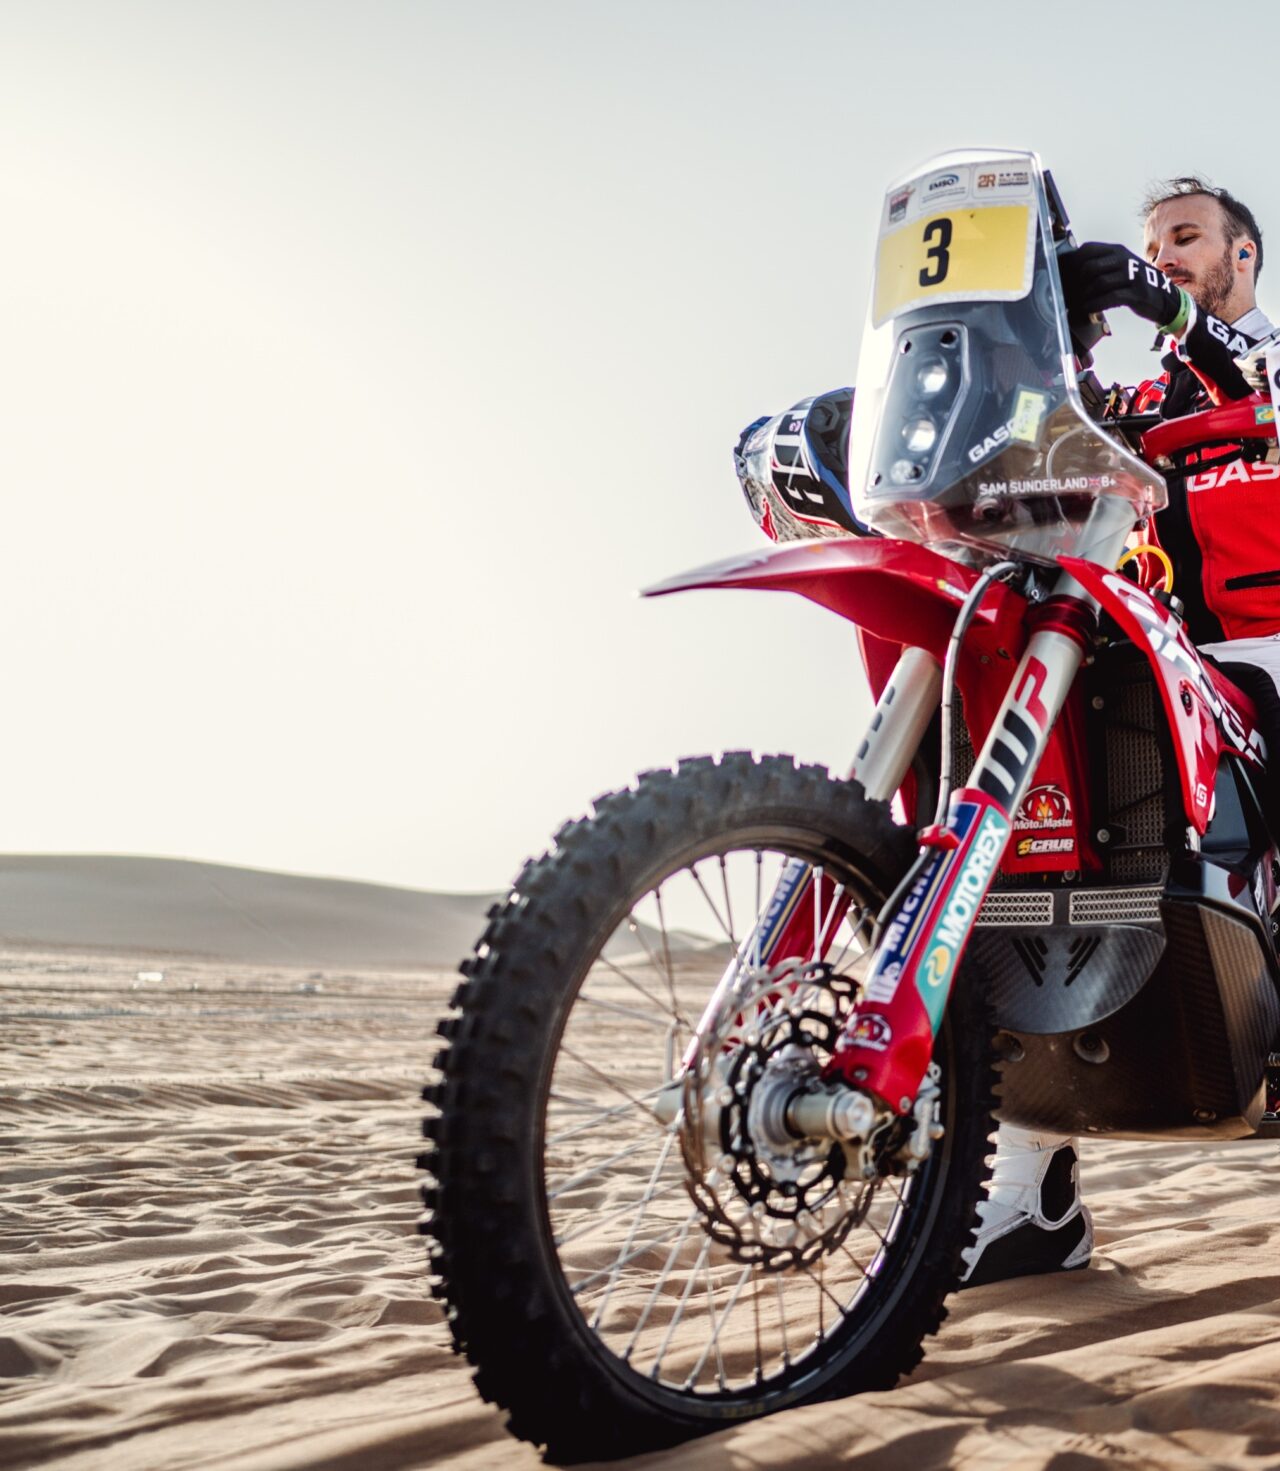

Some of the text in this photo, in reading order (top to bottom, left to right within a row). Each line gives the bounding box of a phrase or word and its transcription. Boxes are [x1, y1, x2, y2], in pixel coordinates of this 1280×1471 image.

[918, 217, 953, 288] 3
[1127, 258, 1172, 294] FOX
[979, 481, 1007, 496] SAM
[1009, 476, 1088, 494] SUNDERLAND
[1018, 838, 1074, 856] SCRUB
[935, 817, 1008, 950] MOTOREX
